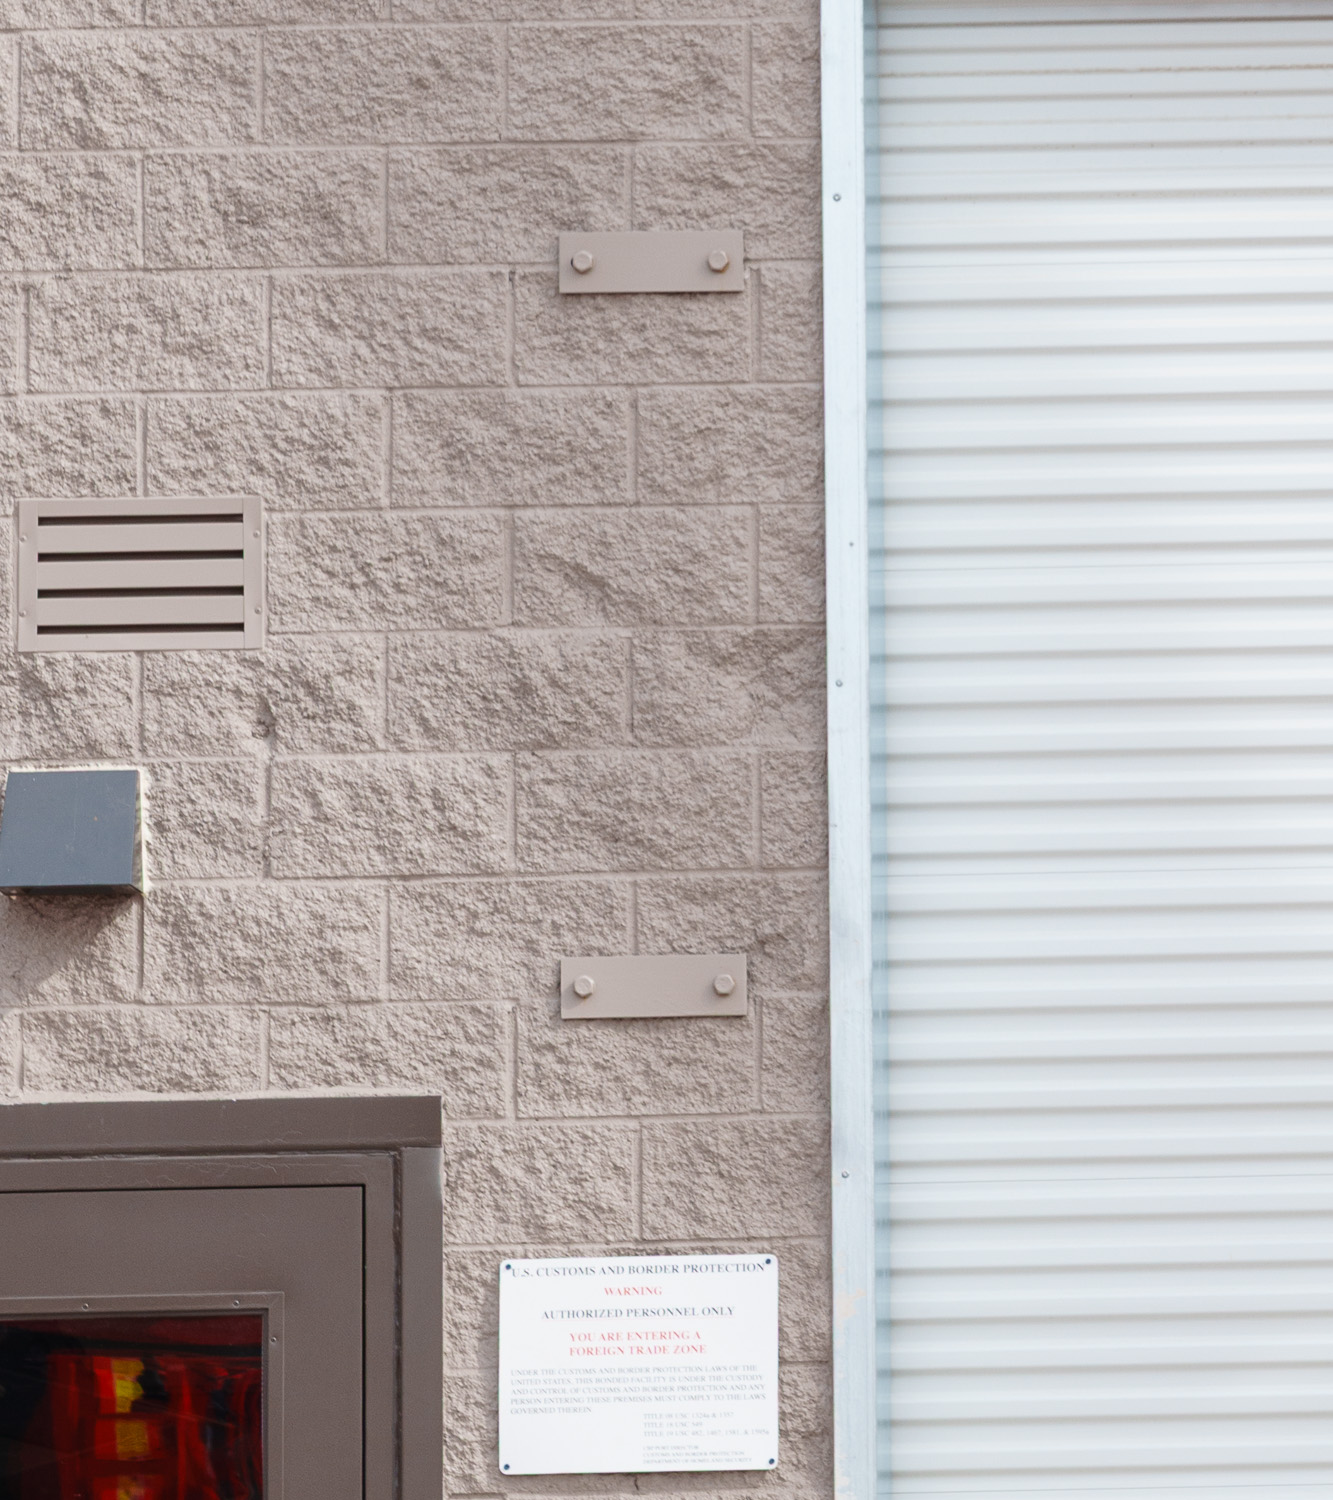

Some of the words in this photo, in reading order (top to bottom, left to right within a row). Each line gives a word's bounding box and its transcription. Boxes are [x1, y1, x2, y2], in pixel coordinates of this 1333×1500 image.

[510, 1268, 532, 1277] U.S.
[535, 1266, 596, 1276] CUSTOMS
[599, 1266, 624, 1275] AND
[628, 1264, 679, 1274] BORDER
[682, 1262, 764, 1273] PROTECTION
[603, 1285, 662, 1296] WARNING
[541, 1308, 623, 1319] AUTHORIZED
[626, 1306, 699, 1317] PERSONNEL
[700, 1306, 735, 1316] ONLY
[569, 1332, 594, 1342] YOU
[599, 1331, 623, 1341] ARE
[626, 1330, 690, 1341] ENTERING
[693, 1329, 702, 1339] A
[569, 1345, 626, 1356] FOREIGN
[628, 1344, 669, 1355] TRADE
[672, 1343, 706, 1354] ZONE
[557, 1367, 596, 1375] CUSTOMS
[617, 1366, 650, 1374] BORDER
[652, 1365, 702, 1373] PROTECTION
[740, 1363, 757, 1371] THE
[510, 1378, 541, 1386] UNITED
[574, 1377, 593, 1385] THIS
[594, 1376, 629, 1384] BONDED
[630, 1375, 666, 1383] FACILITY
[678, 1374, 705, 1382] UNDER
[724, 1373, 762, 1381] CUSTODY
[529, 1387, 566, 1395] CONTROL
[581, 1386, 621, 1394] CUSTOMS
[623, 1385, 640, 1393] AND
[676, 1383, 727, 1392] PROTECTION
[510, 1397, 542, 1406] PERSON
[543, 1396, 584, 1405] ENTERING
[586, 1396, 611, 1404] THESE
[613, 1395, 652, 1403] PREMISES
[653, 1394, 676, 1402] MUST
[678, 1393, 710, 1402] COMPLY
[714, 1393, 724, 1401] TO
[743, 1392, 766, 1400] LAWS
[510, 1406, 556, 1415] GOVERNED
[557, 1406, 592, 1414] THEREIN
